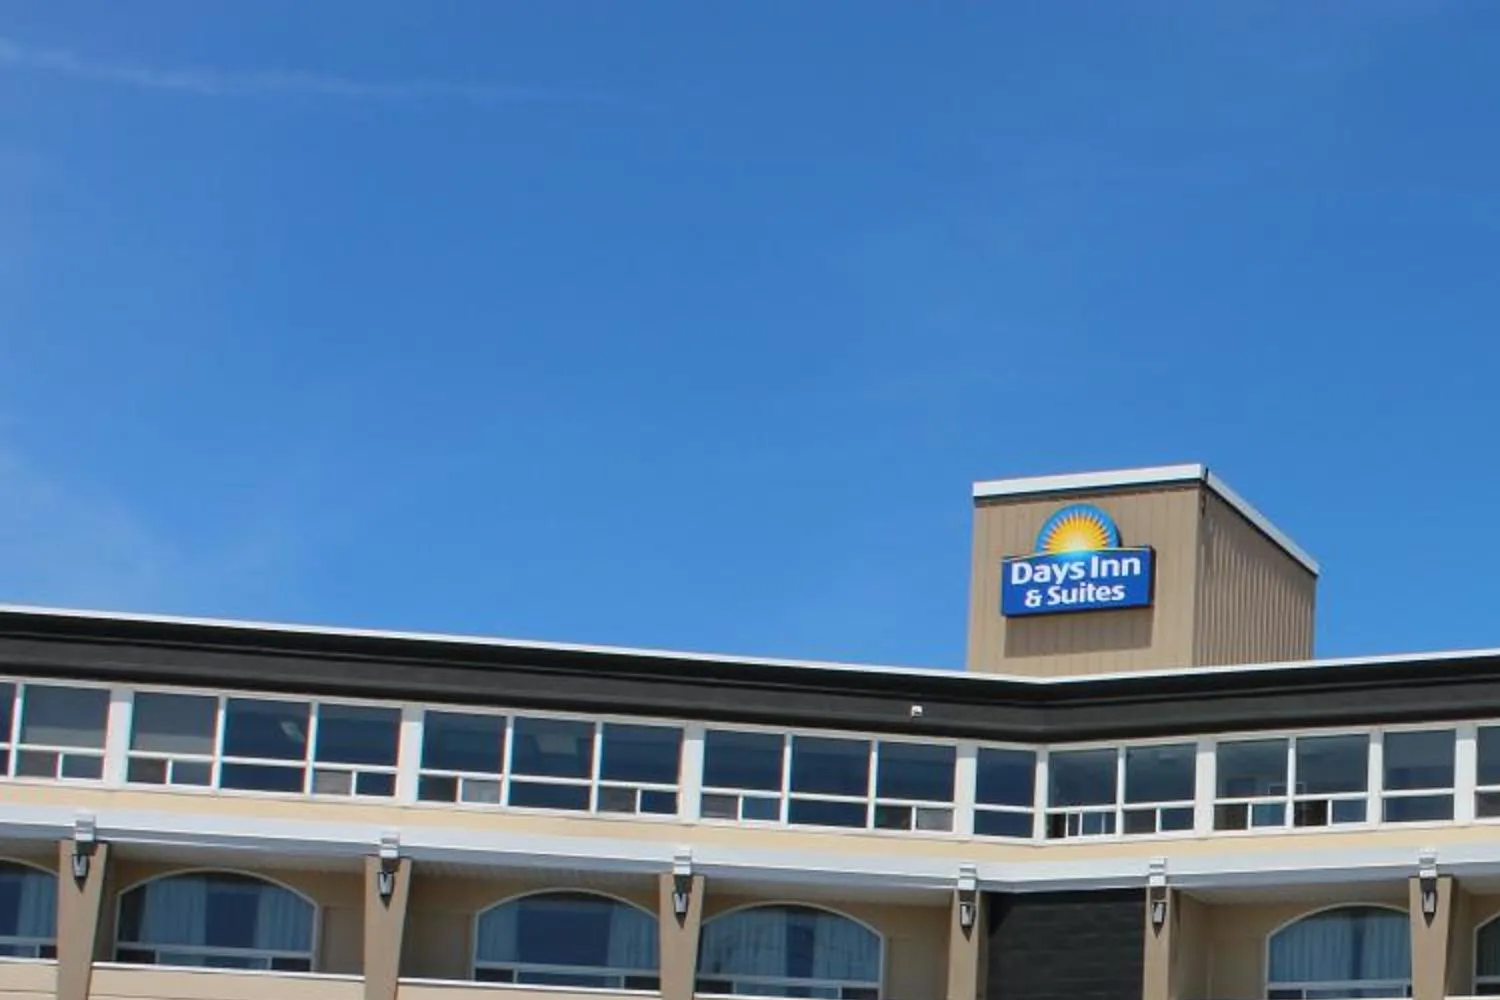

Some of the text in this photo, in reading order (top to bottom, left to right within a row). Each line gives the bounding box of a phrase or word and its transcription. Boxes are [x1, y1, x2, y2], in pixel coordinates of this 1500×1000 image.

[1011, 556, 1141, 585] Days Inn
[1024, 581, 1125, 607] & Suites
